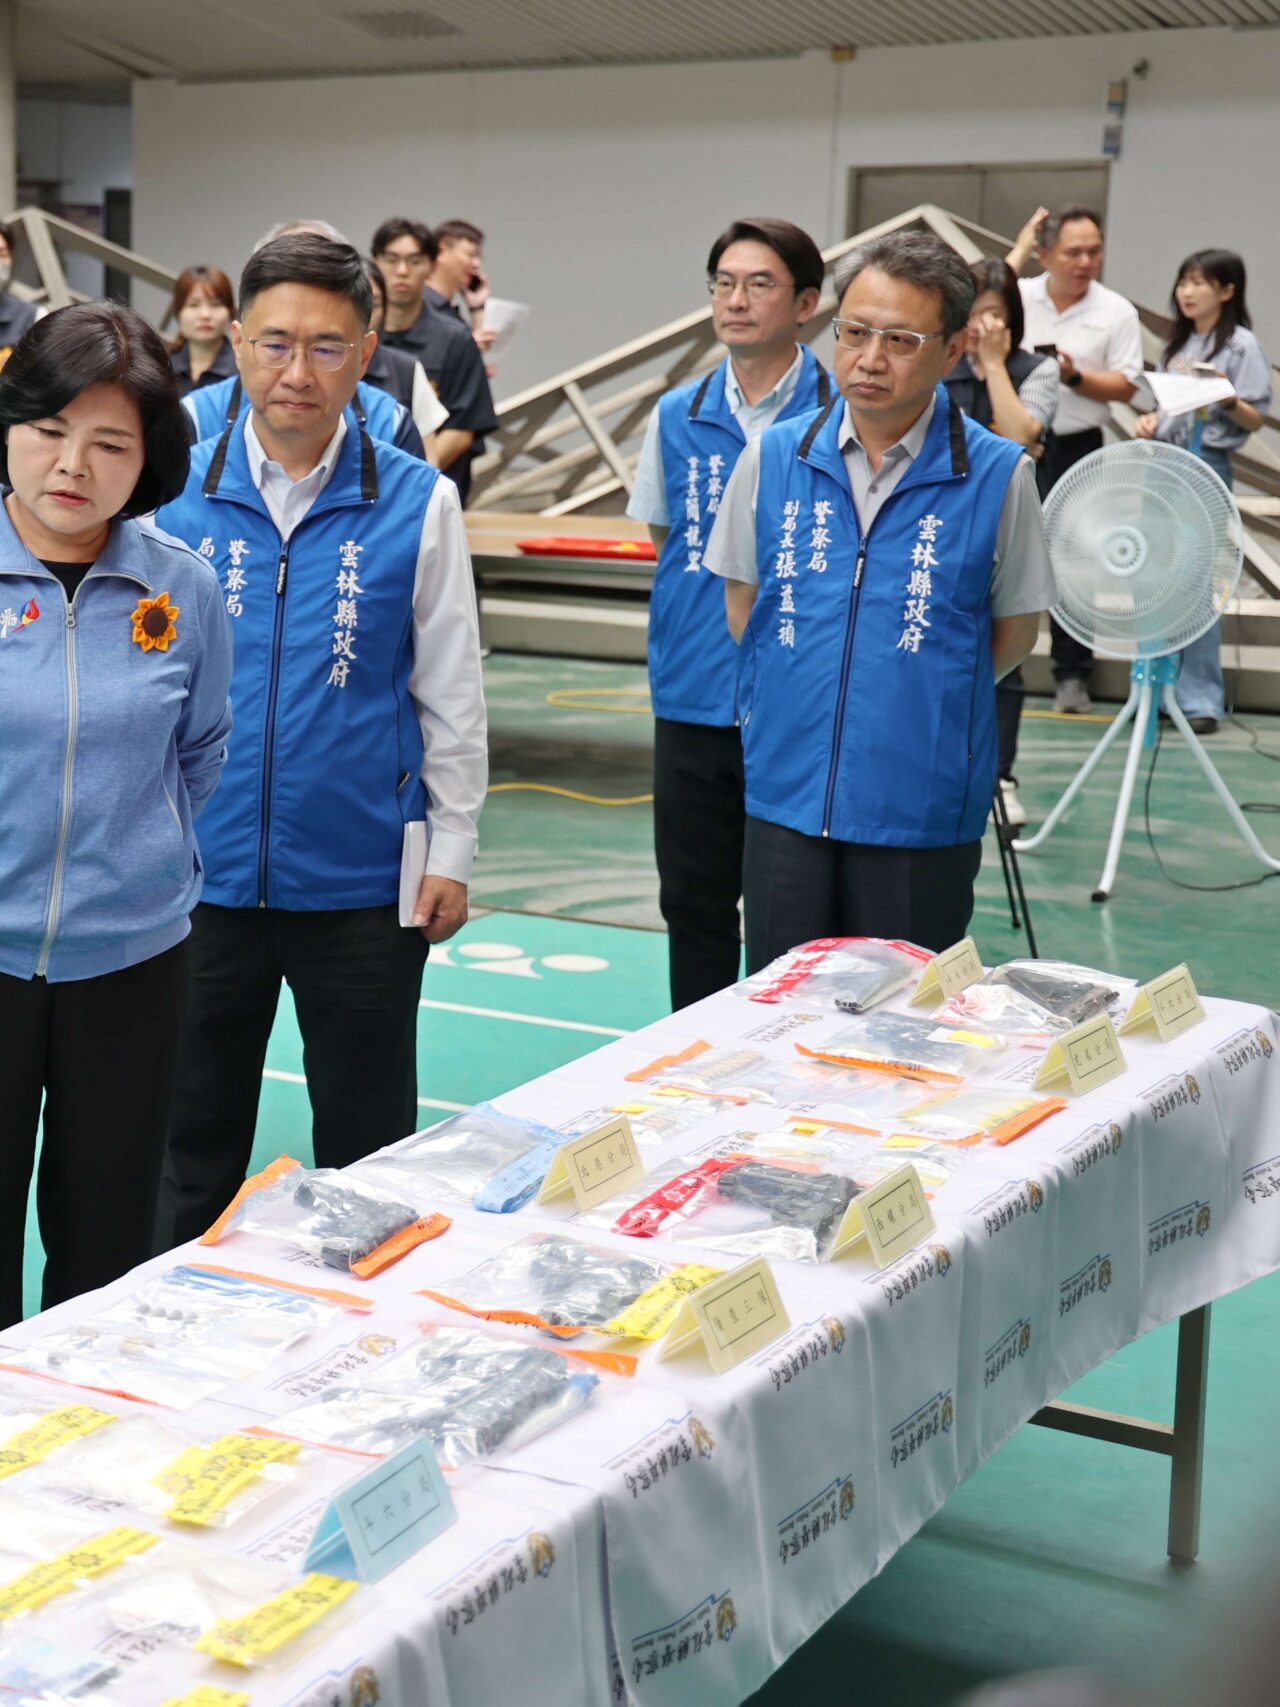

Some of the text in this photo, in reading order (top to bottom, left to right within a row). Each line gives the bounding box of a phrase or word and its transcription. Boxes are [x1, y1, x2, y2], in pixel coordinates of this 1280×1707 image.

[224, 539, 250, 617] 警察局
[807, 500, 834, 573] 警察局
[896, 514, 944, 653] 雲林縣政府
[326, 540, 365, 688] 雲林縣政府
